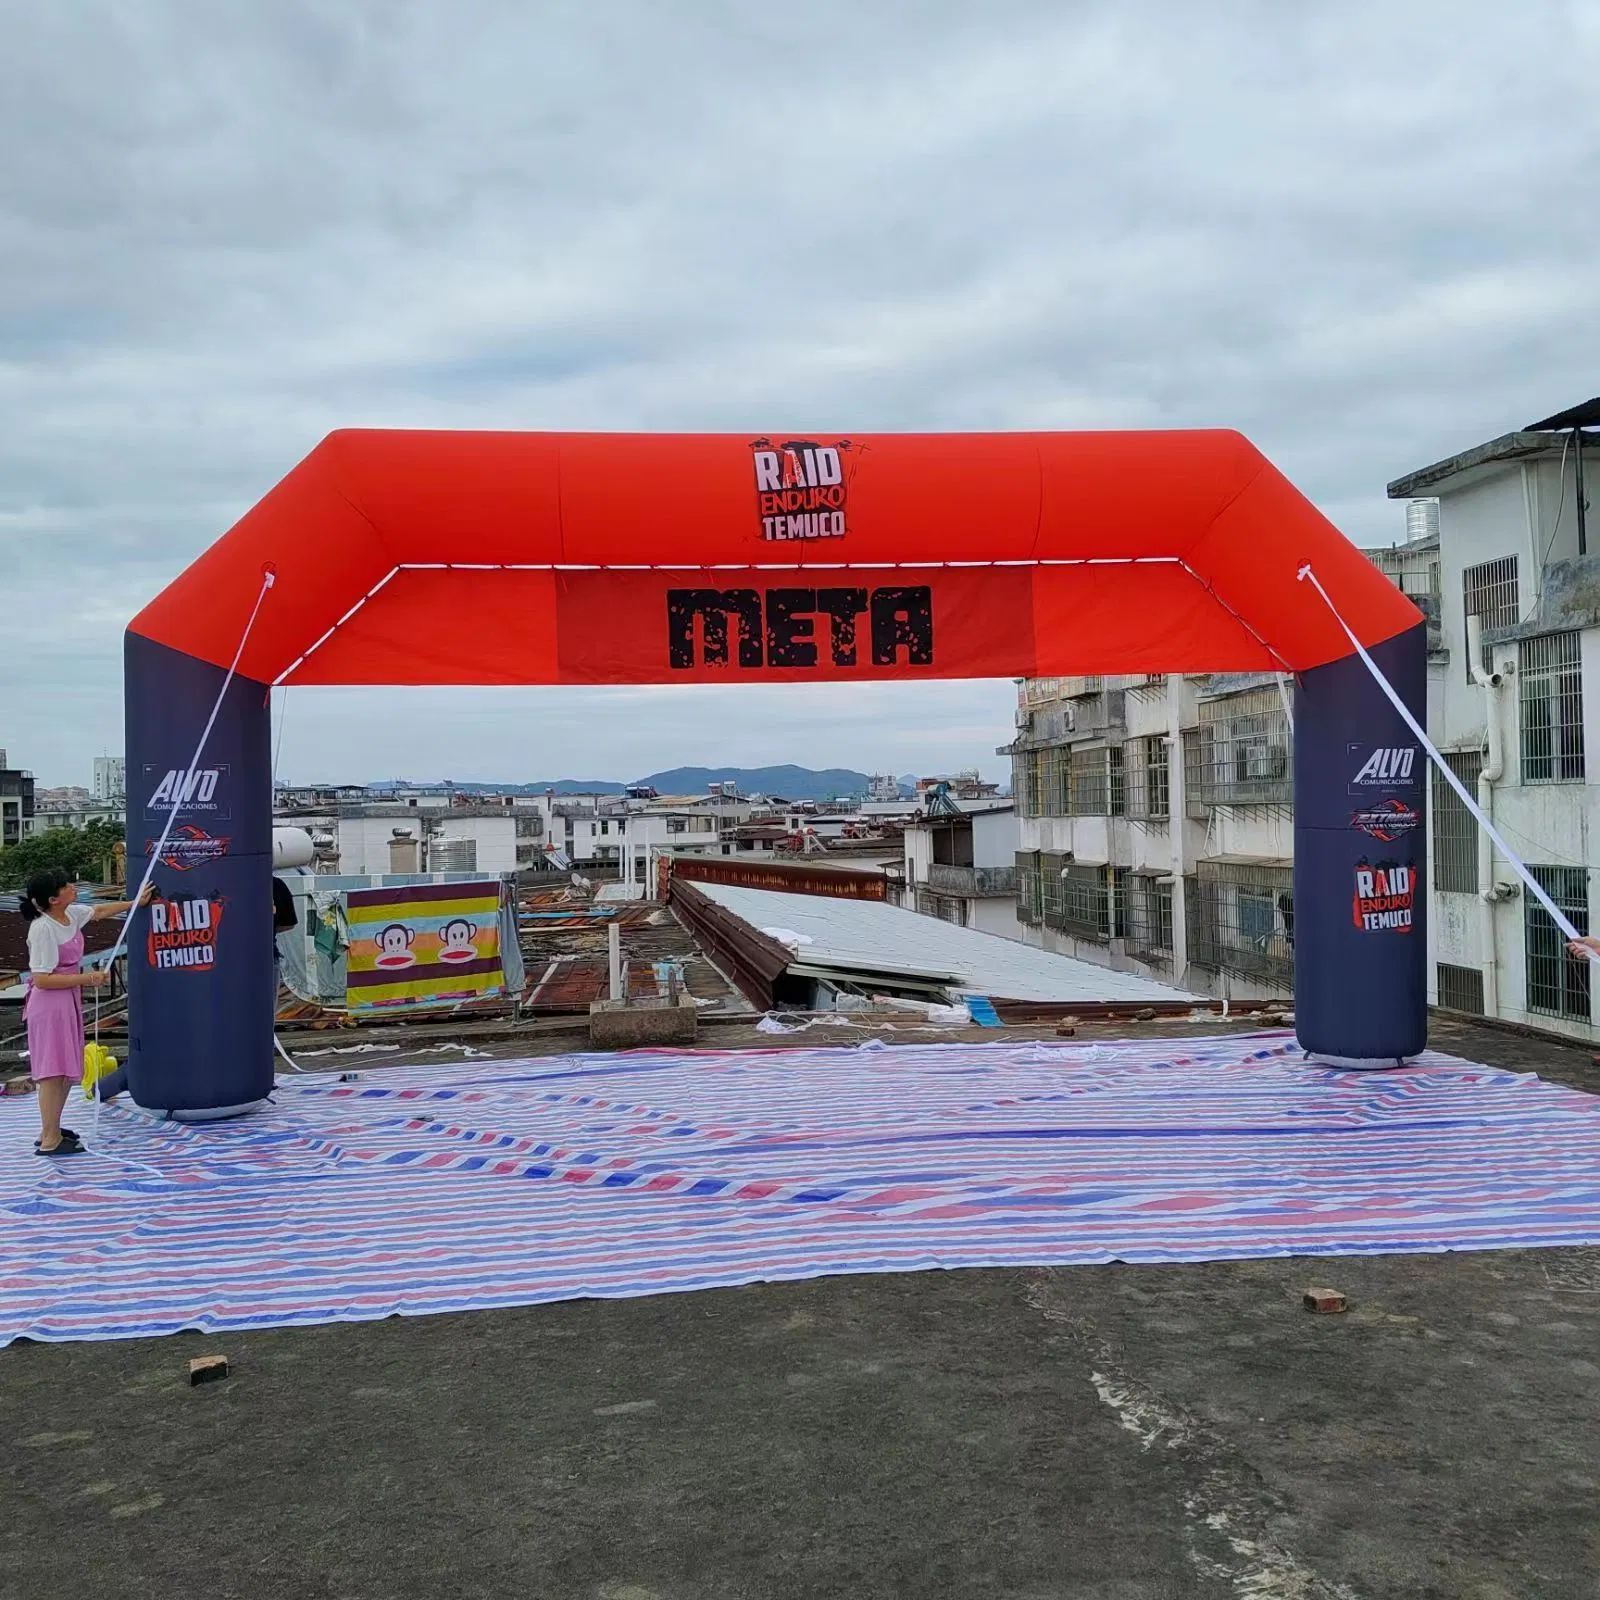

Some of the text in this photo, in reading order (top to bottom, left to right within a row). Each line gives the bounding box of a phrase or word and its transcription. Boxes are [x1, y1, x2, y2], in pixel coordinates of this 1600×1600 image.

[754, 448, 842, 491] RAID
[761, 486, 845, 515] ENDURO
[763, 511, 845, 540] TEMUCO
[667, 586, 932, 668] META
[1353, 749, 1414, 783] ALVO
[1357, 867, 1409, 898] RAID
[152, 900, 210, 933] RAID
[1361, 894, 1410, 912] ENDURO
[1362, 909, 1411, 930] TEMUCO
[155, 929, 212, 949] ENDURO
[156, 945, 213, 968] TEMUCO
